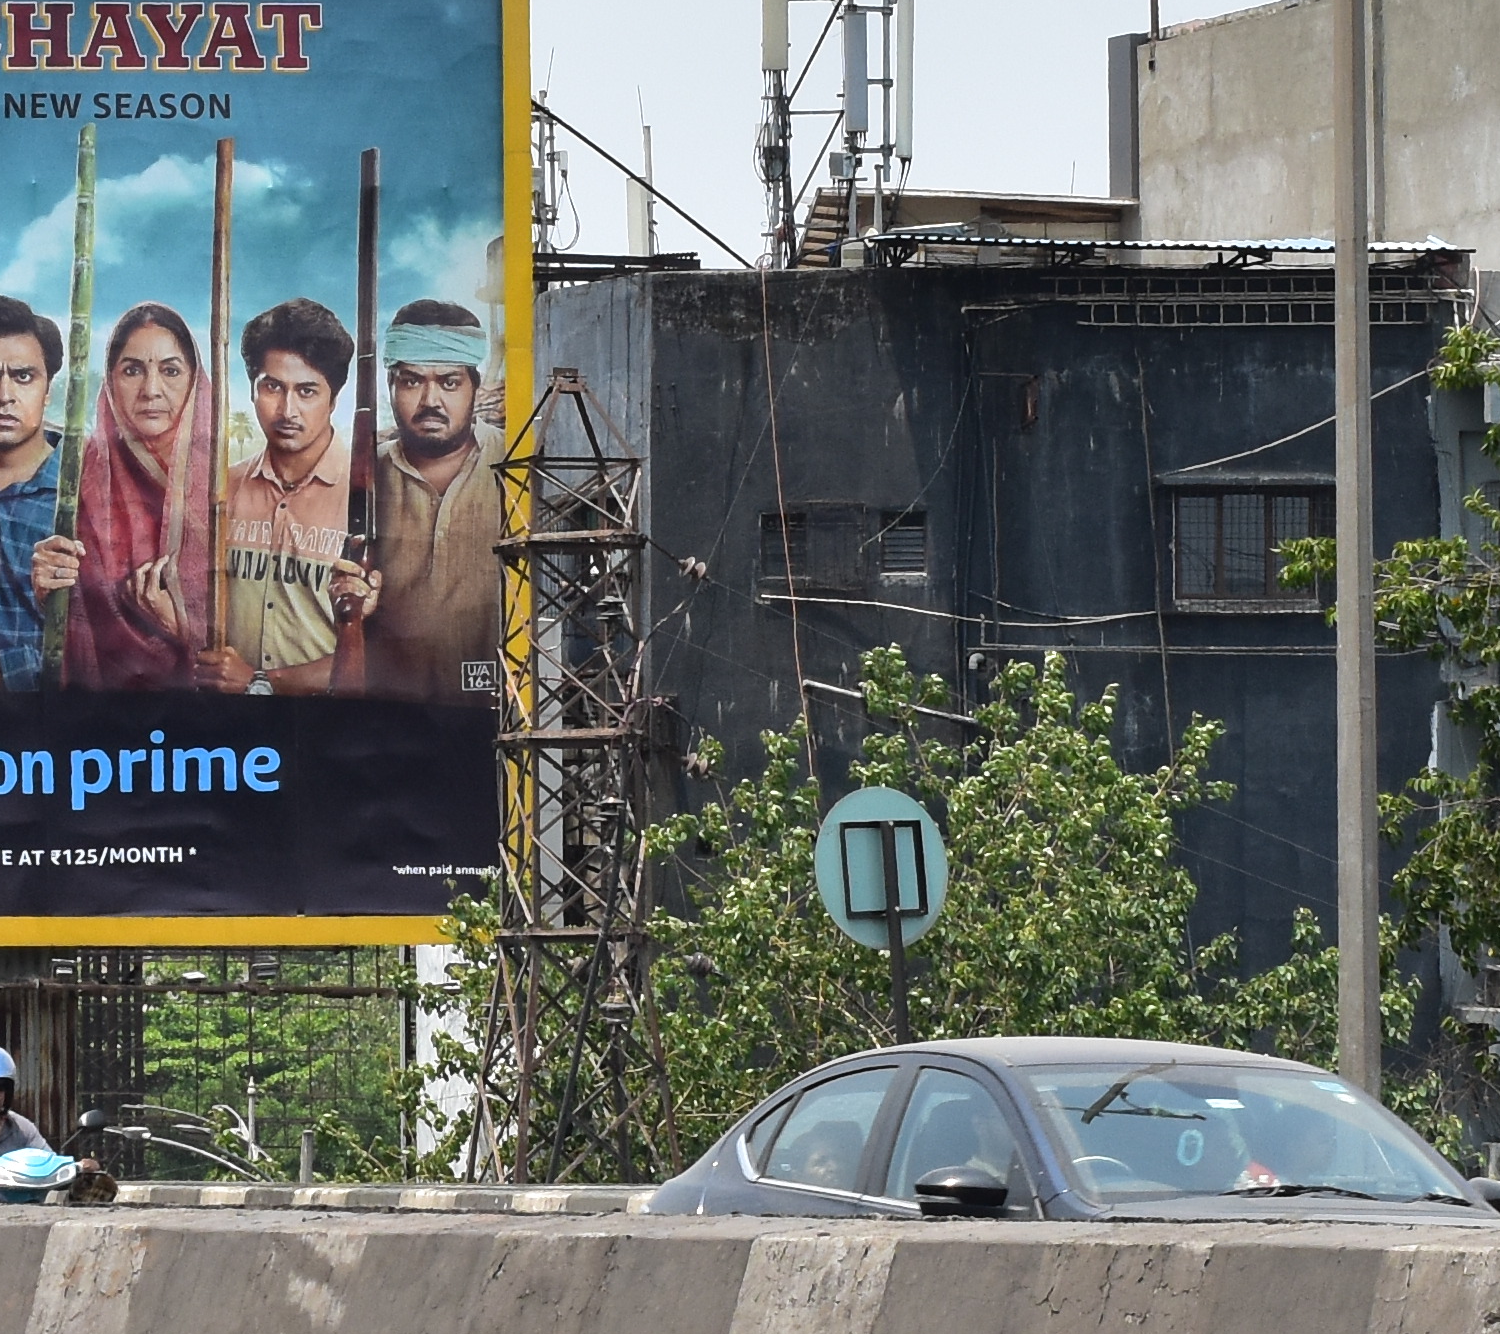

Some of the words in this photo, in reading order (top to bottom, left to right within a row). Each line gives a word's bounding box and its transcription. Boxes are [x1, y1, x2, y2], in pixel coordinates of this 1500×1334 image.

[4, 93, 81, 118] NEW
[93, 93, 231, 119] SEASON
[467, 664, 490, 676] U/A
[468, 677, 491, 688] 16+
[70, 730, 281, 811] prime
[18, 849, 44, 865] AT
[50, 846, 184, 866] ₹125/MONTH
[429, 864, 452, 876] paid
